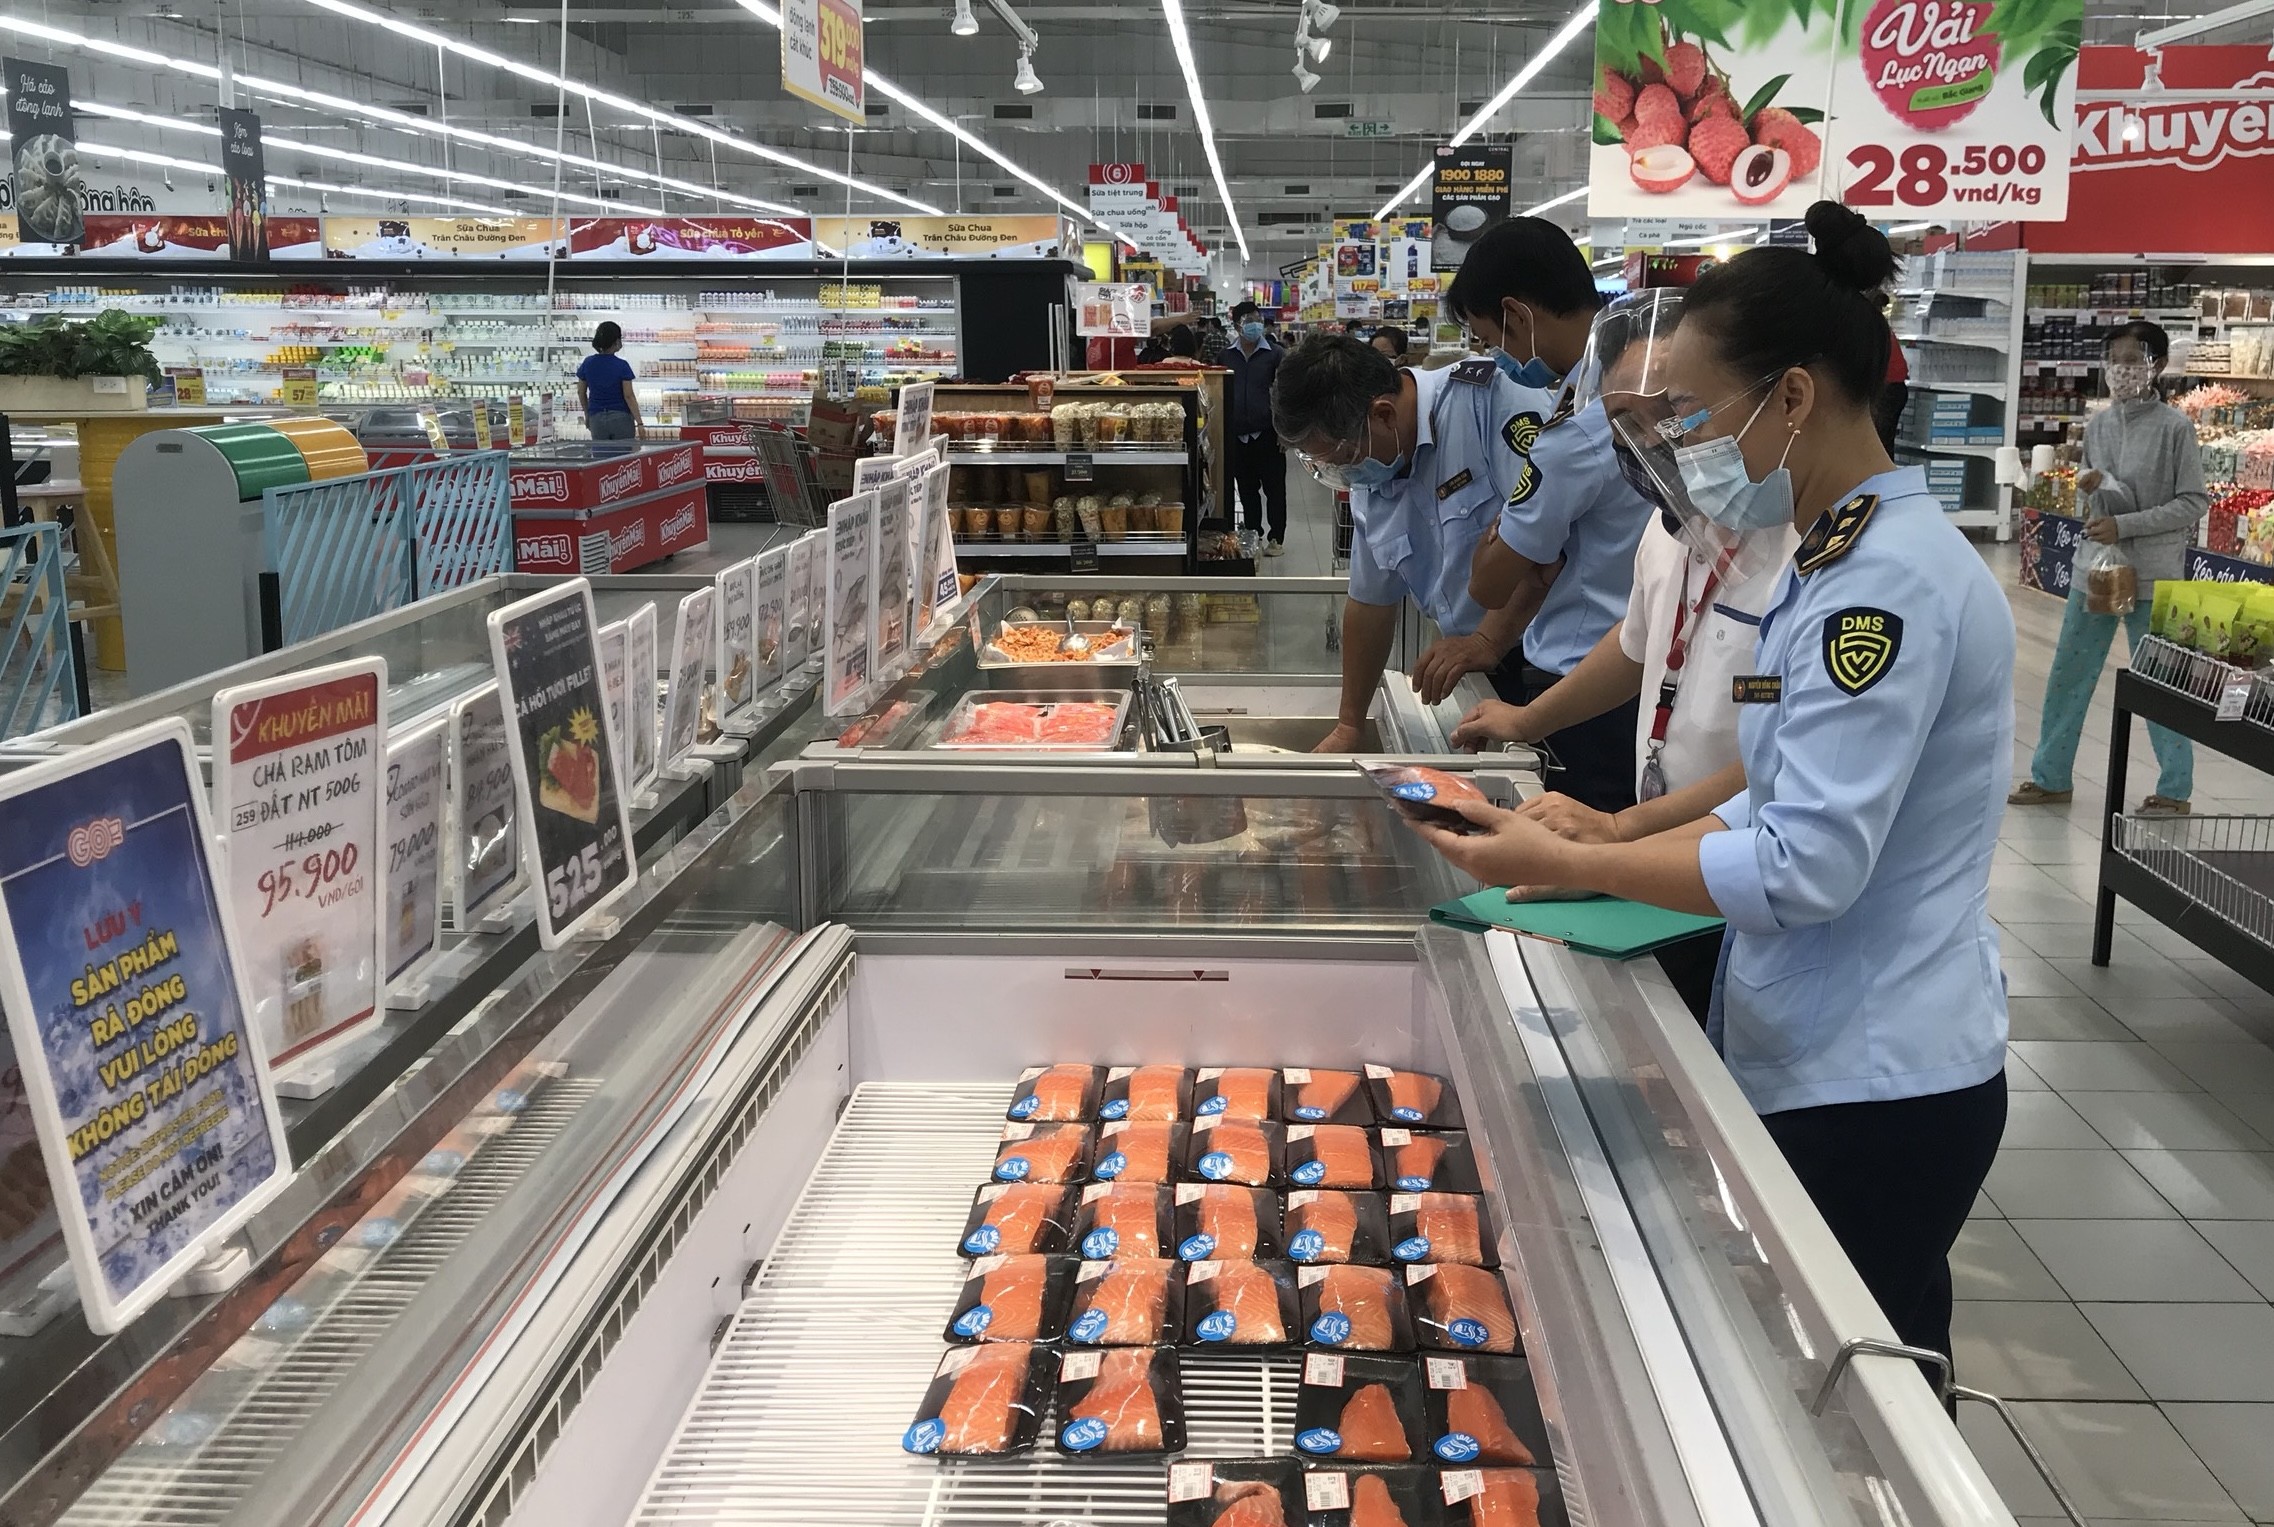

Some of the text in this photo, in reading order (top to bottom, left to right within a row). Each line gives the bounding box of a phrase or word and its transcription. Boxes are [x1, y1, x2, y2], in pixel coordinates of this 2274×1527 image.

[1869, 0, 1977, 57] Vải
[1877, 50, 1989, 90] Lục Ngạn
[19, 73, 37, 94] Há
[15, 96, 64, 120] đông lạnh
[1113, 167, 1122, 179] 6
[1439, 168, 1505, 181] 1900 1880
[1953, 182, 2041, 206] vnd/kg
[475, 224, 501, 232] Chua
[508, 234, 526, 242] Đen
[948, 223, 992, 232] Sữa Chua
[968, 233, 998, 243] Đường
[1000, 233, 1018, 241] Đen
[177, 387, 192, 400] 28
[292, 389, 305, 401] 57
[1510, 416, 1531, 433] DMS
[1841, 616, 1885, 632] DMS
[336, 690, 370, 723] MÃI
[291, 747, 331, 779] RAM
[333, 737, 368, 764] TÔM
[297, 785, 322, 813] NT
[326, 773, 361, 801] 500G
[236, 808, 256, 827] 259
[257, 841, 358, 918] 95.900
[84, 910, 126, 951] LƯU
[70, 928, 179, 1008] SẢN PHẨM
[125, 973, 187, 1022] ĐÔNG
[99, 1013, 198, 1091] VUI LÒNG
[66, 1030, 239, 1163] KHÔNG TÁI ĐÔNG
[190, 1171, 222, 1203] YOU!
[130, 1190, 159, 1223] XIN
